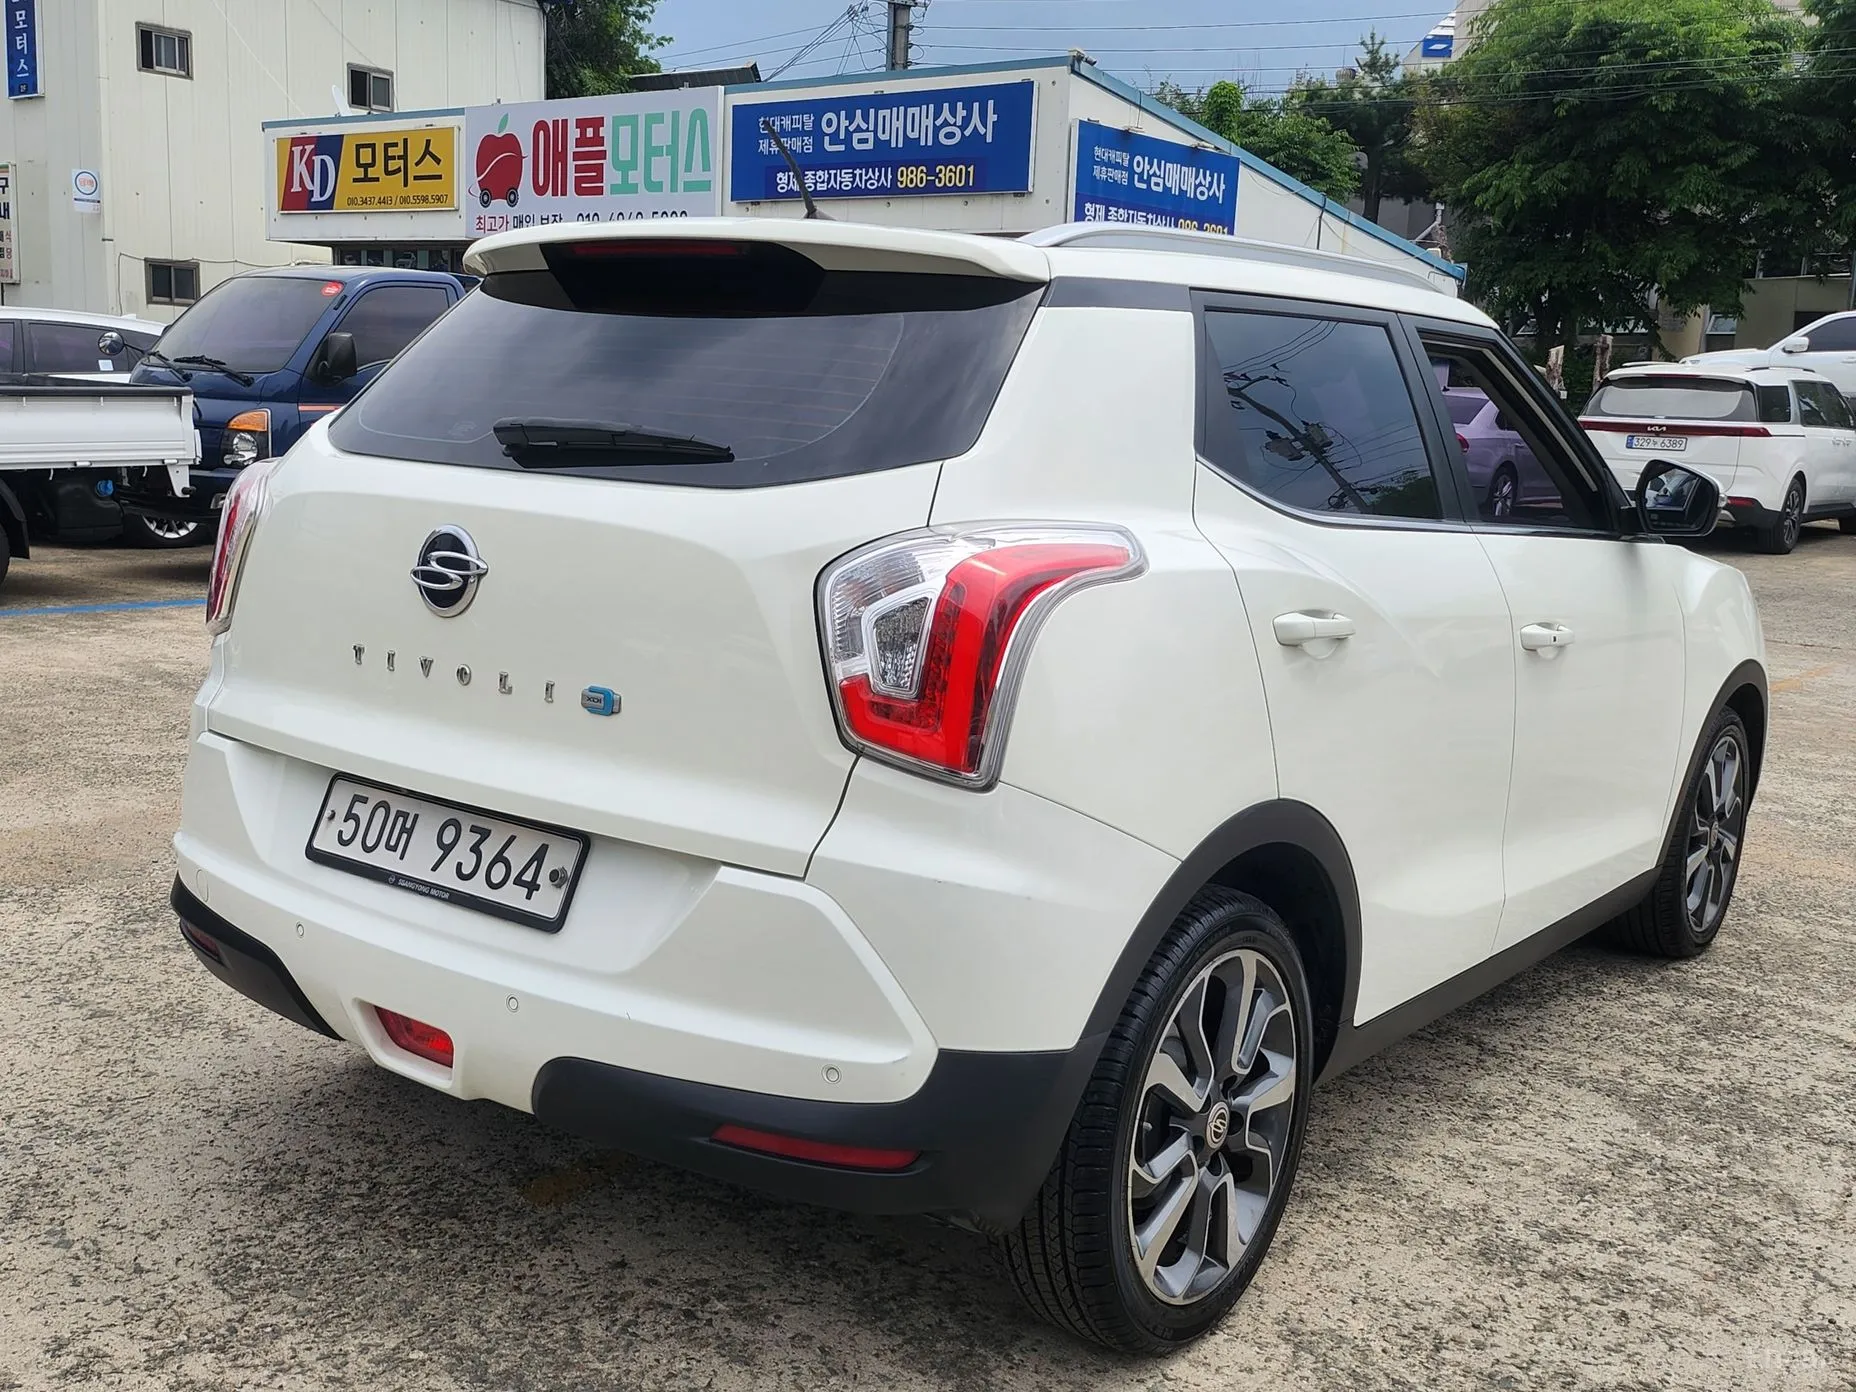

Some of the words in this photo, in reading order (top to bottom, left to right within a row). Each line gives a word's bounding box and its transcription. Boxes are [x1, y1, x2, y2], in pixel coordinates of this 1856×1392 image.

[821, 100, 998, 152] 안심매매상사
[291, 144, 336, 202] KD
[352, 138, 443, 188] 모터스
[531, 108, 712, 197] 애플모터스
[1094, 145, 1130, 168] 현대캐피탈
[804, 167, 892, 192] 종합자동차상사
[897, 165, 976, 188] 986-3601
[1133, 155, 1226, 204] 안심매매상사
[475, 214, 510, 233] 최고가
[1660, 439, 1684, 449] 6389
[352, 643, 556, 704] TIVOLI
[337, 793, 419, 861] 50머
[430, 817, 550, 901] 9364
[398, 878, 430, 894] SSANGYONG
[430, 888, 450, 900] MOTOR
